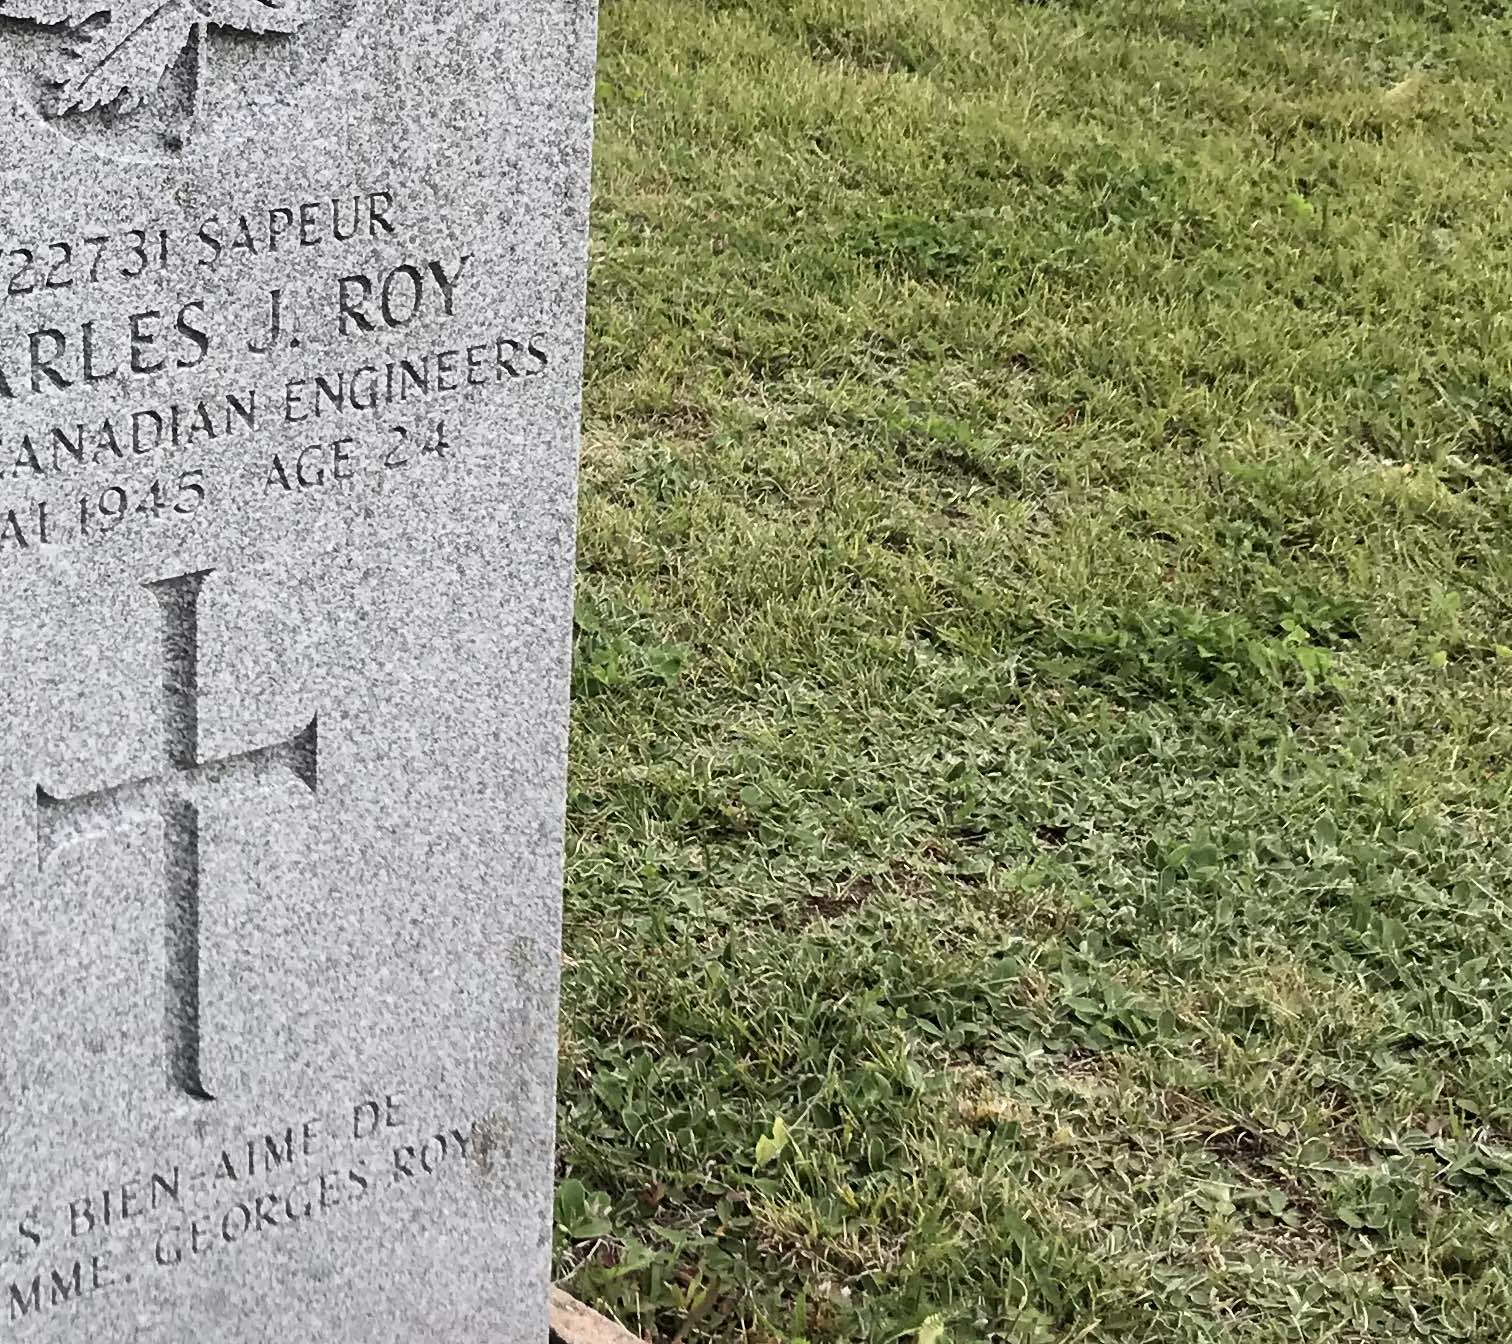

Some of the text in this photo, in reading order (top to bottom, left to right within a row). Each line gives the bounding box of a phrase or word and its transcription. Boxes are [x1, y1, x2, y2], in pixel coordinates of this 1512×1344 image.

[198, 191, 396, 269] SAPEUR
[248, 289, 300, 355] J.
[336, 254, 475, 339] ROY
[285, 332, 551, 424] ENGINEERS
[80, 469, 206, 538] 1945
[260, 436, 354, 496] AGE
[383, 418, 452, 471] 24
[353, 1090, 405, 1139] DE
[154, 1168, 369, 1265] GEORGES
[393, 1121, 480, 1181] ROY
